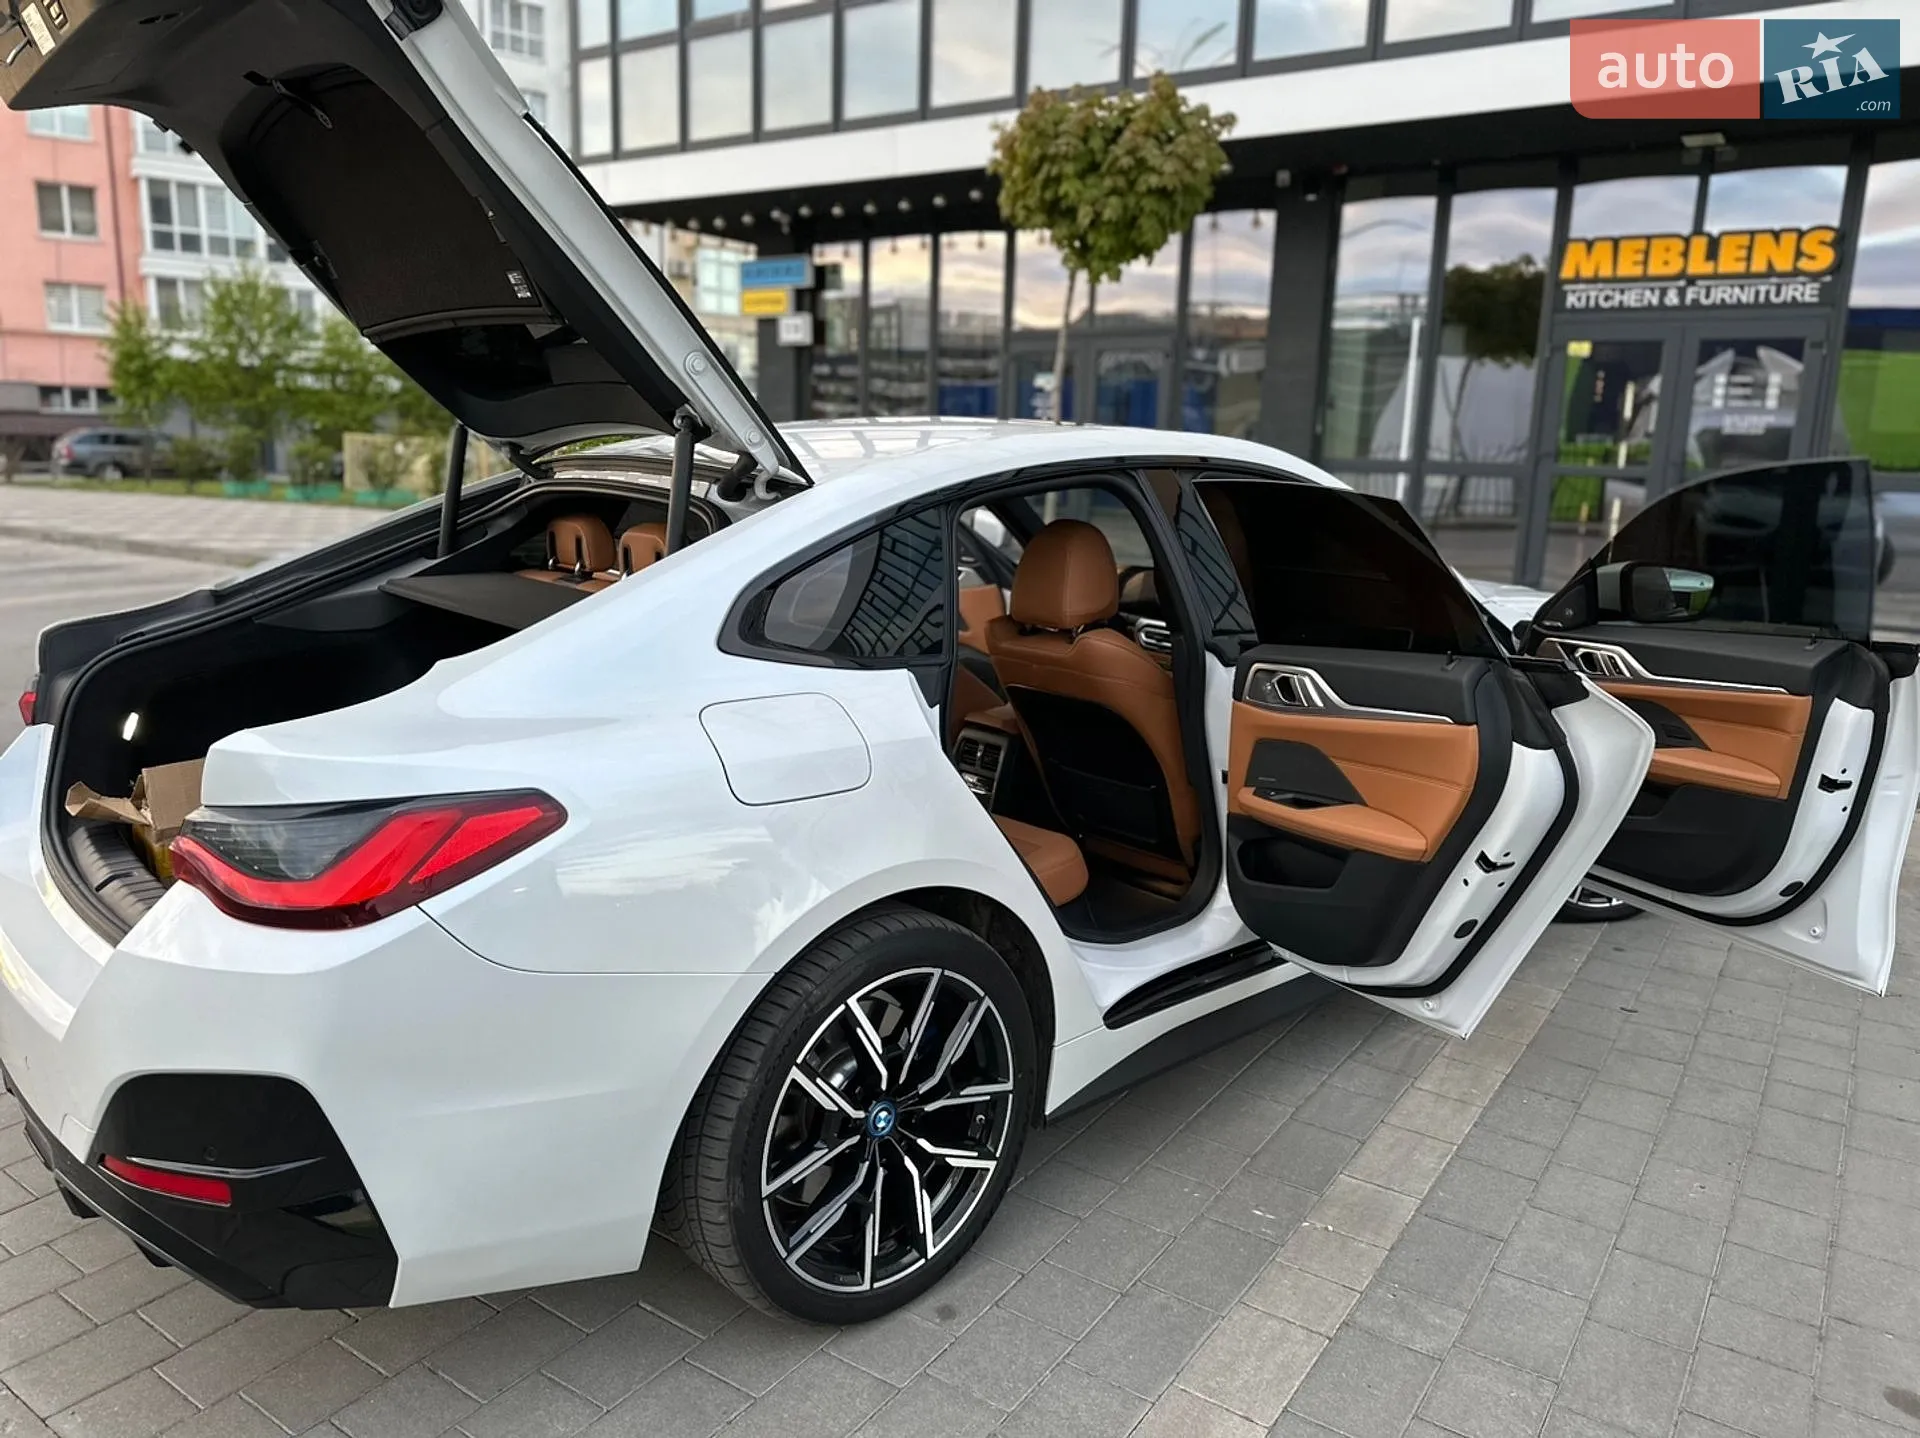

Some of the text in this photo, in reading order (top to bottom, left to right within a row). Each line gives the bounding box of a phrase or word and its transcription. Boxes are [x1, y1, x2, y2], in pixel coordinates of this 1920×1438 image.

[1559, 228, 1837, 280] MEBLENS
[1565, 282, 1821, 309] KITCHEN & FURNITURE
